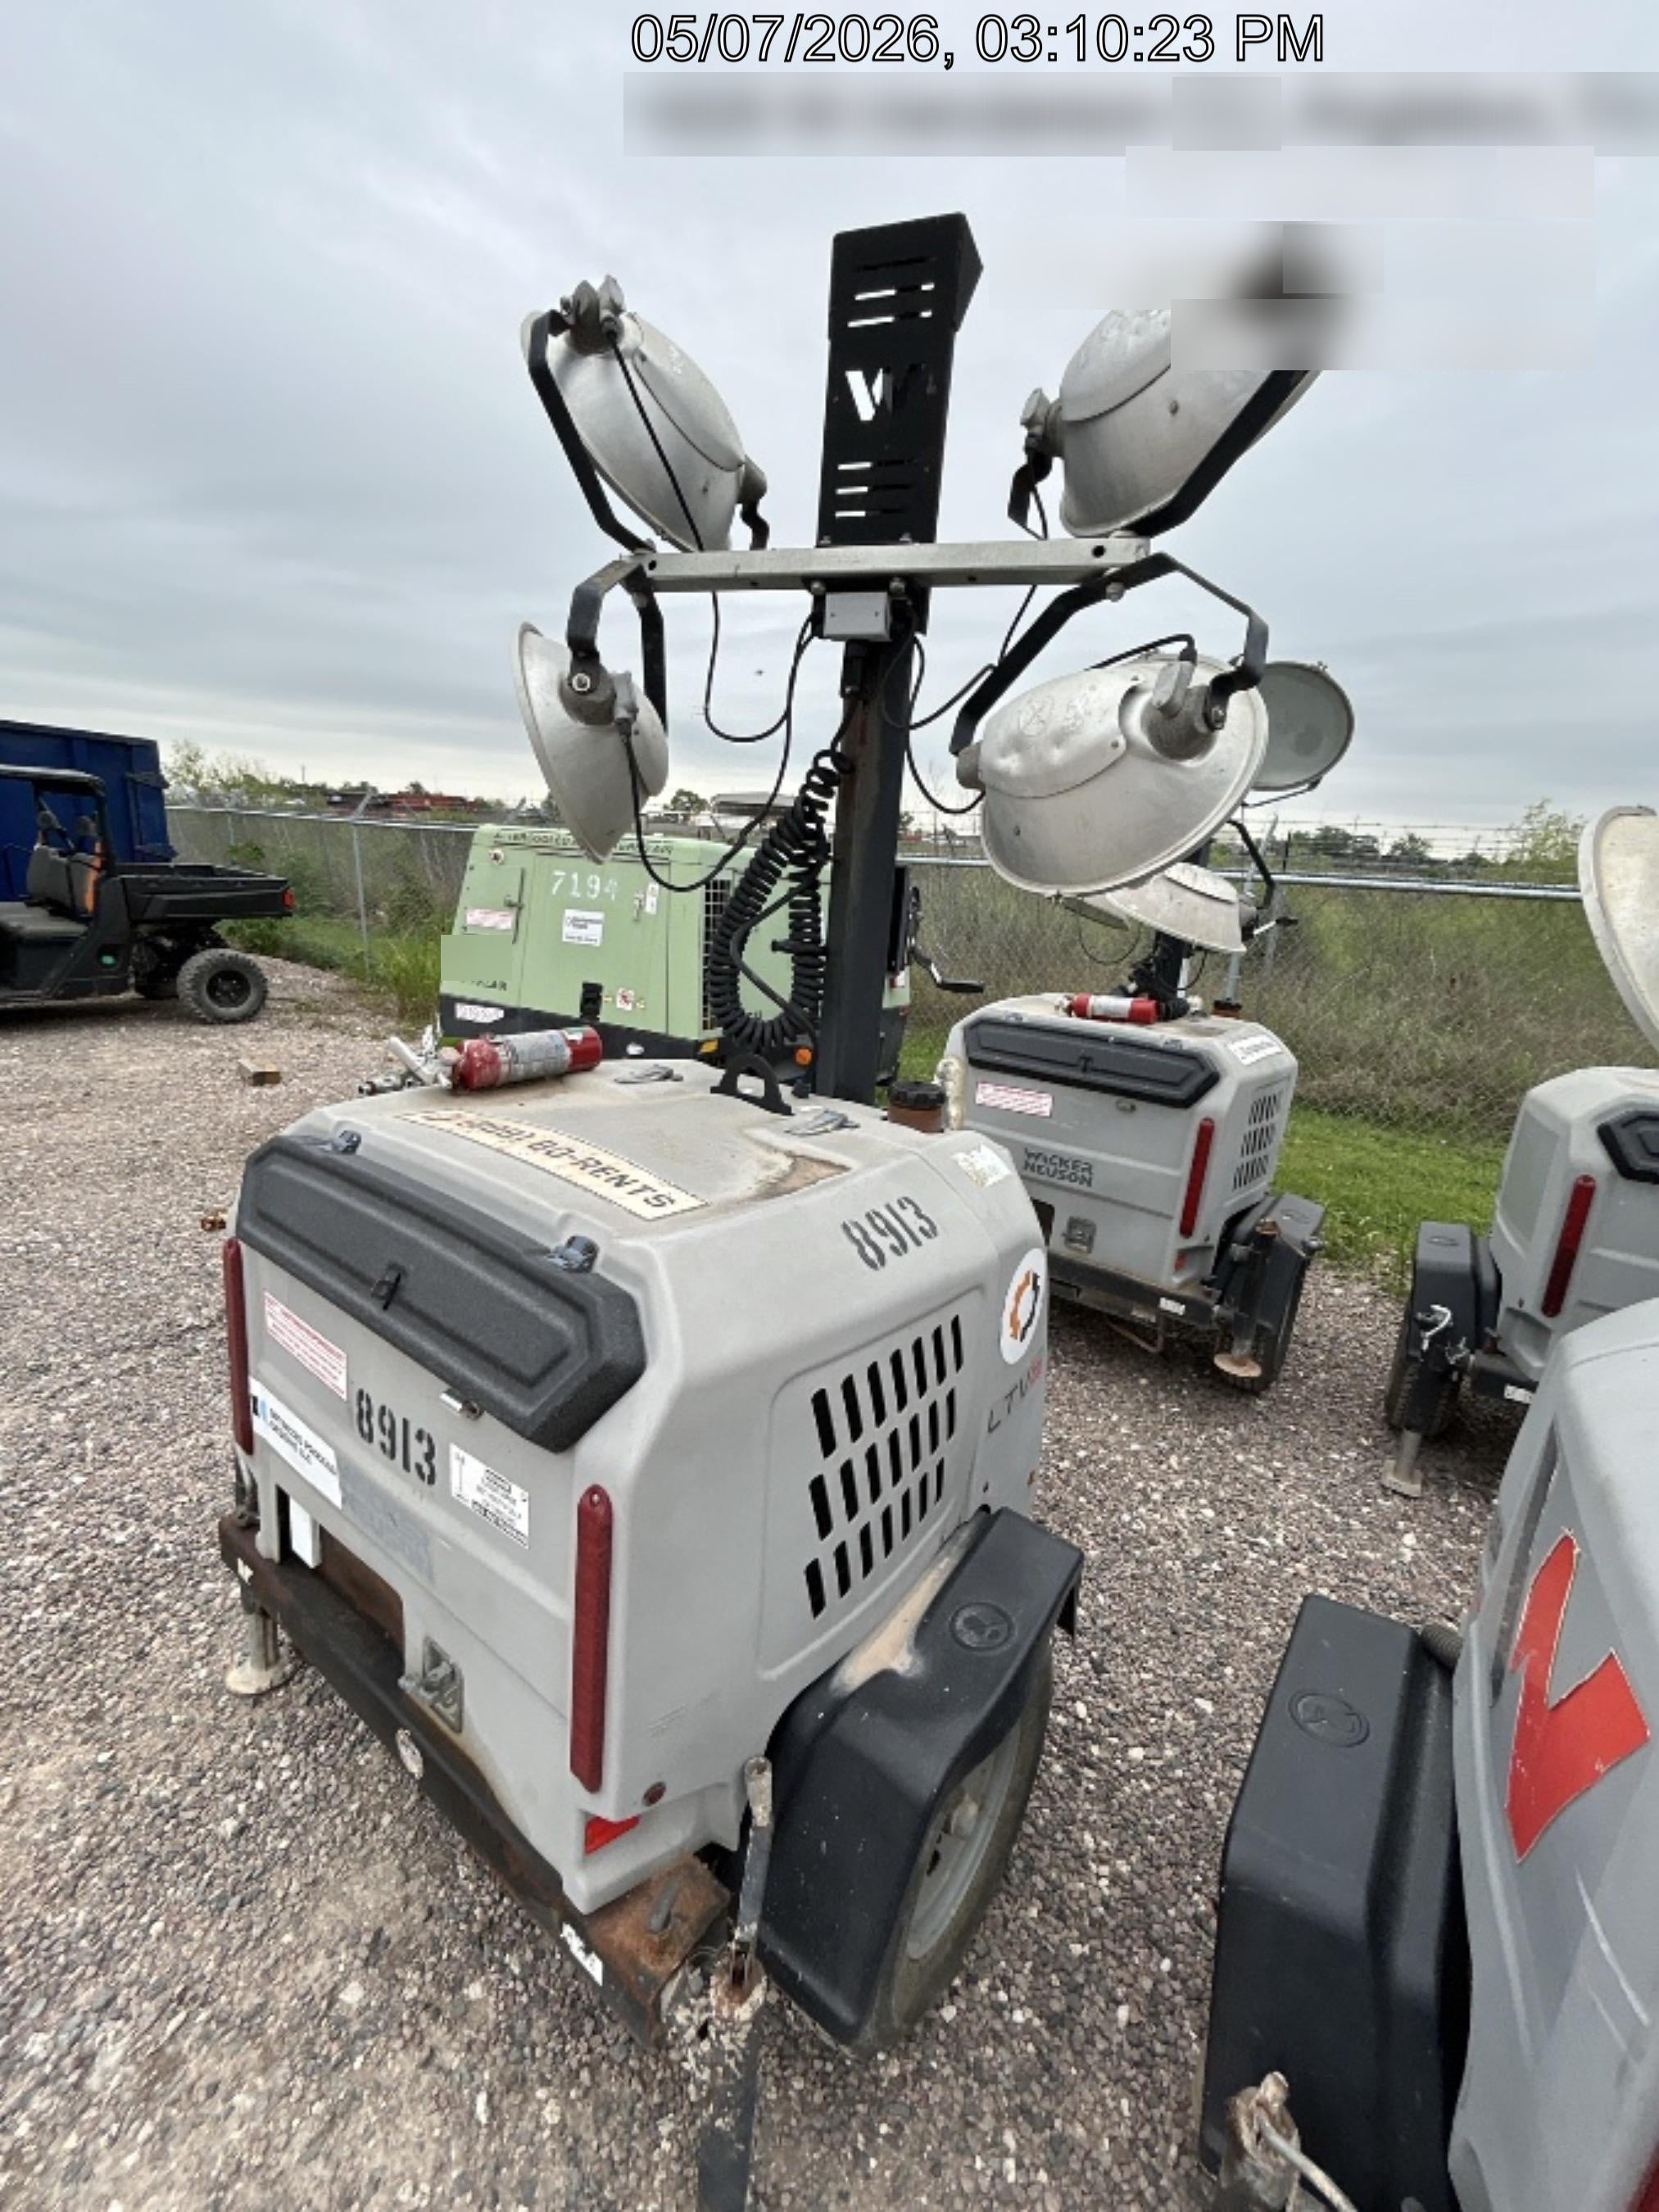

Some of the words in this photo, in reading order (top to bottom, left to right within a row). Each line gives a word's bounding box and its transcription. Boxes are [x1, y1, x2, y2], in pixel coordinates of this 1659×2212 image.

[551, 869, 619, 901] 7194
[841, 1196, 938, 1271] 8913
[356, 1387, 437, 1486] 8913
